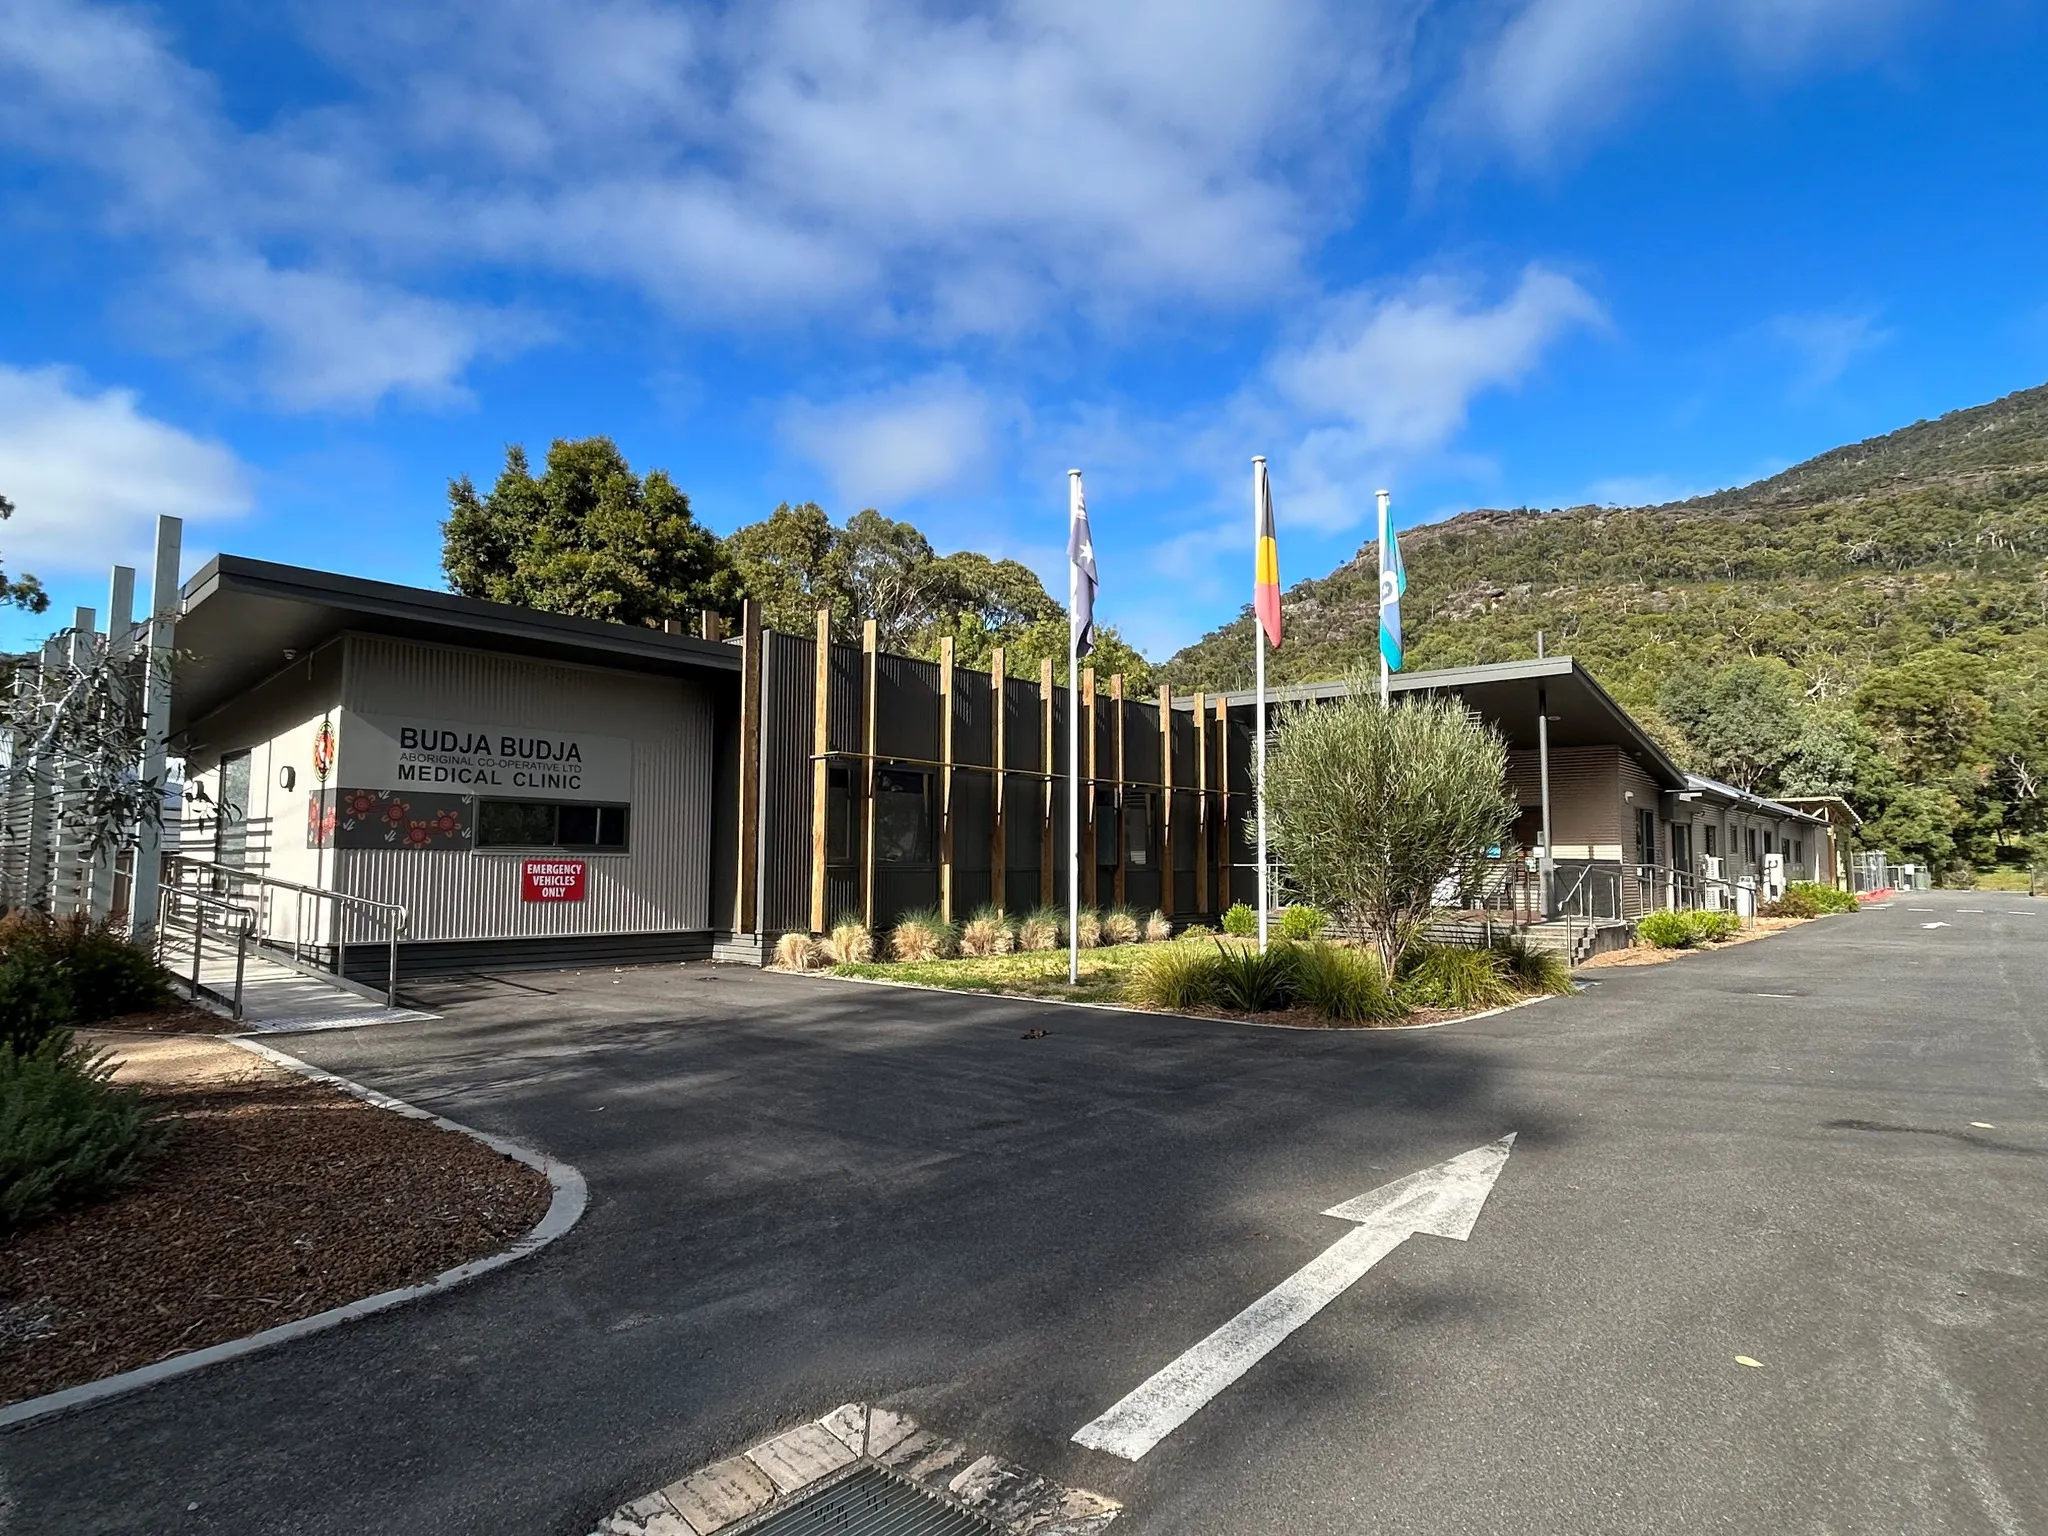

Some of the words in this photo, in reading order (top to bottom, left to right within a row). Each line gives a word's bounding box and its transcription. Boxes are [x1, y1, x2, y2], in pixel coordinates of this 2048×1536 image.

[400, 727, 492, 755] BUDJA
[501, 736, 582, 763] BUDJA
[400, 752, 474, 766] ABORIGINAL
[478, 758, 559, 772] CO-OPERATIVE
[563, 764, 582, 773] LTD
[398, 764, 502, 785] MEDICAL
[513, 772, 581, 790] CLINIC
[527, 864, 582, 875] EMERGENCY
[532, 875, 576, 886] VEHICLES
[541, 887, 566, 898] ONLY
